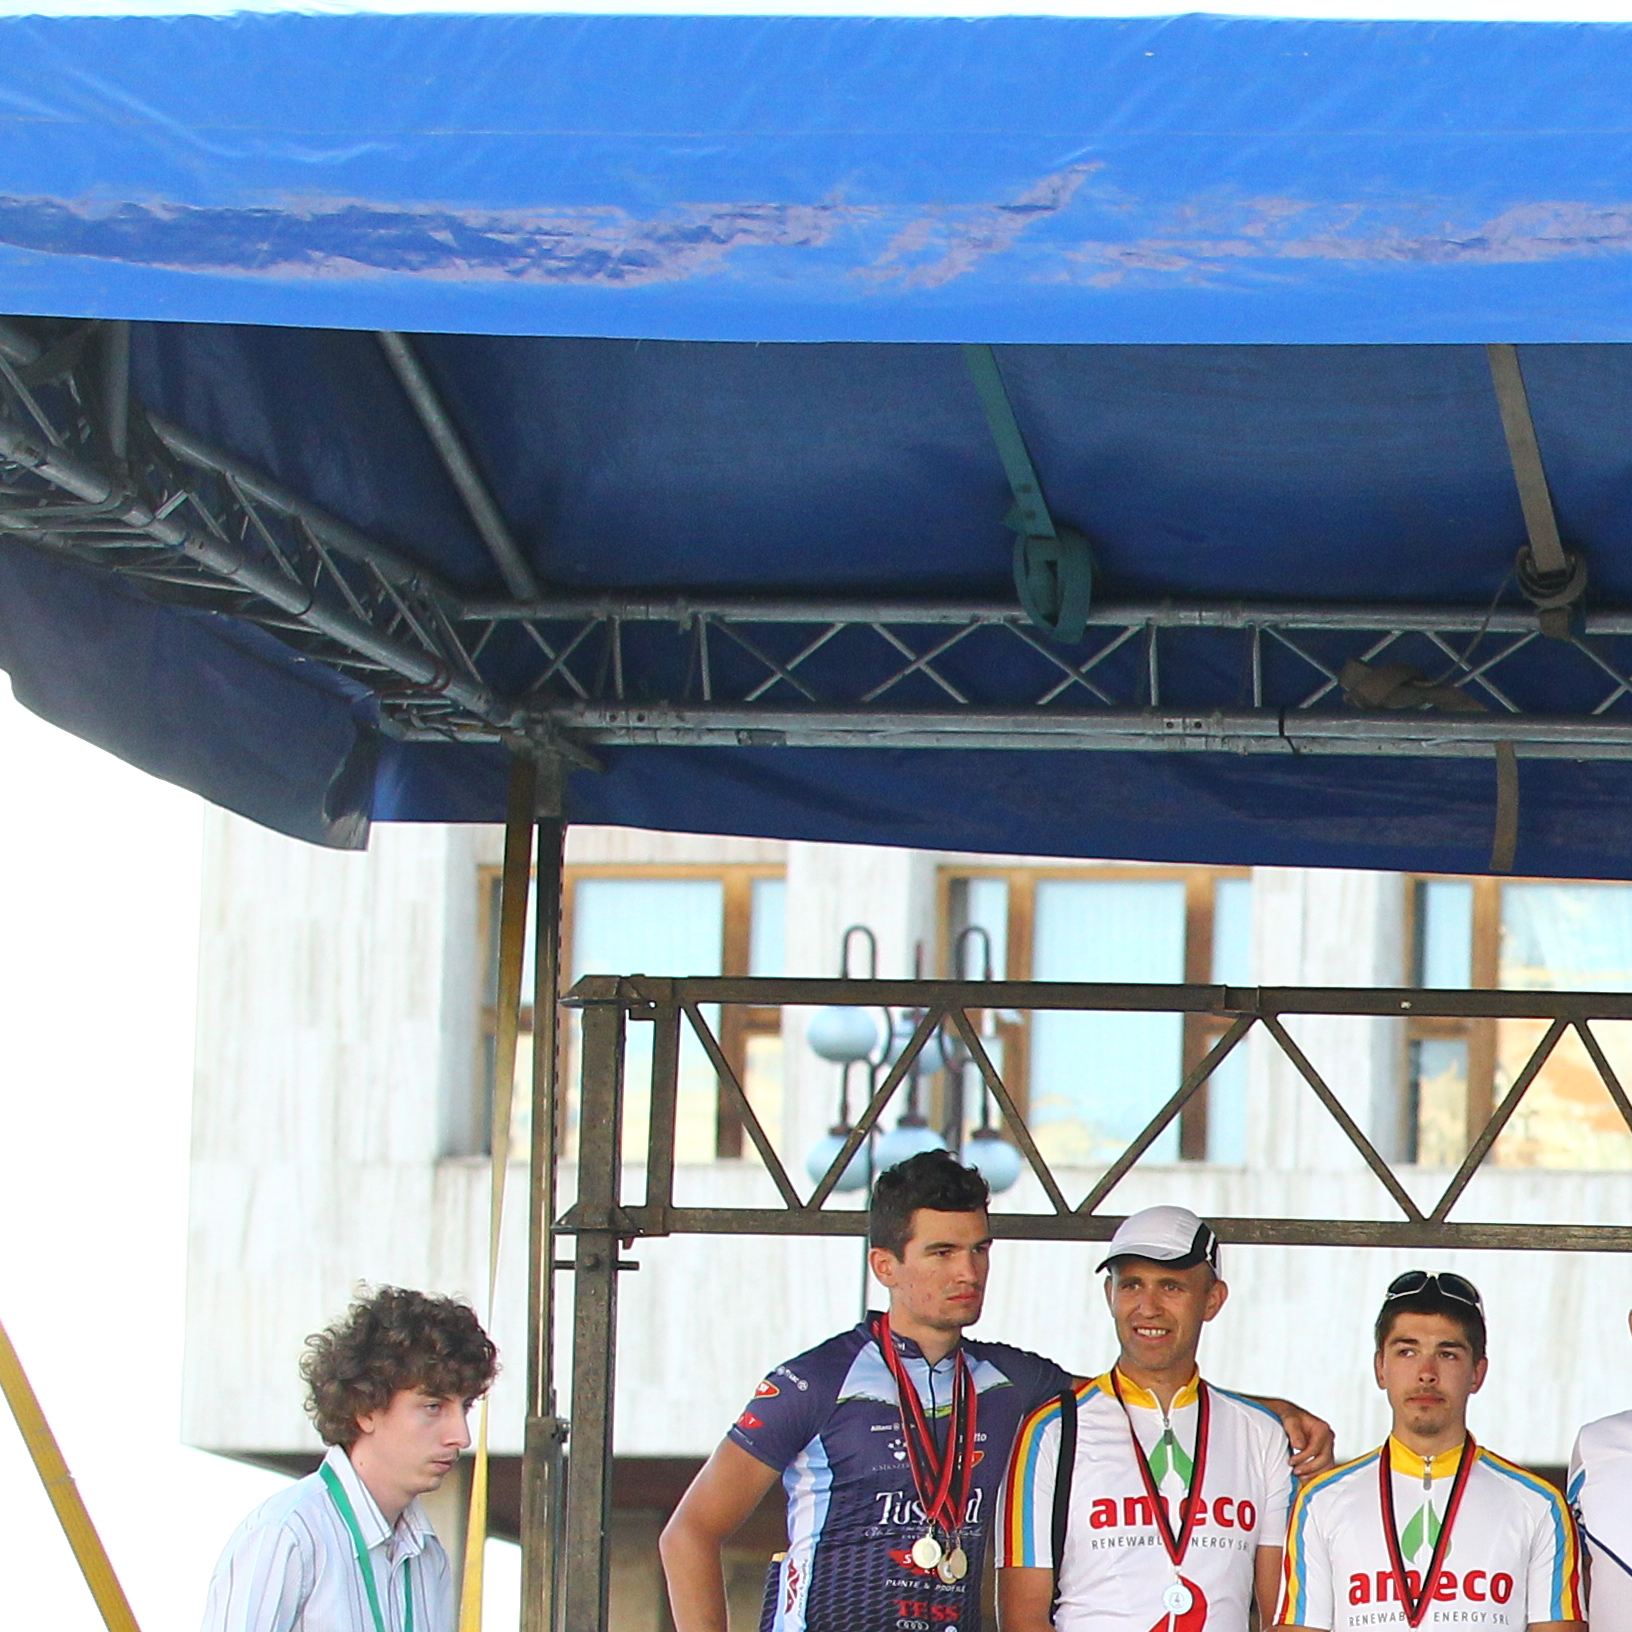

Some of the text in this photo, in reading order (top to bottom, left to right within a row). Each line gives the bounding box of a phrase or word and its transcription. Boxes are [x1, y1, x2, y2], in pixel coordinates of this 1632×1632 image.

[1092, 1535, 1163, 1549] RENEWABL
[1191, 1536, 1233, 1549] NERGY
[893, 1600, 961, 1621] TESS
[1349, 1611, 1510, 1627] RENEWAB ENERGY SRL
